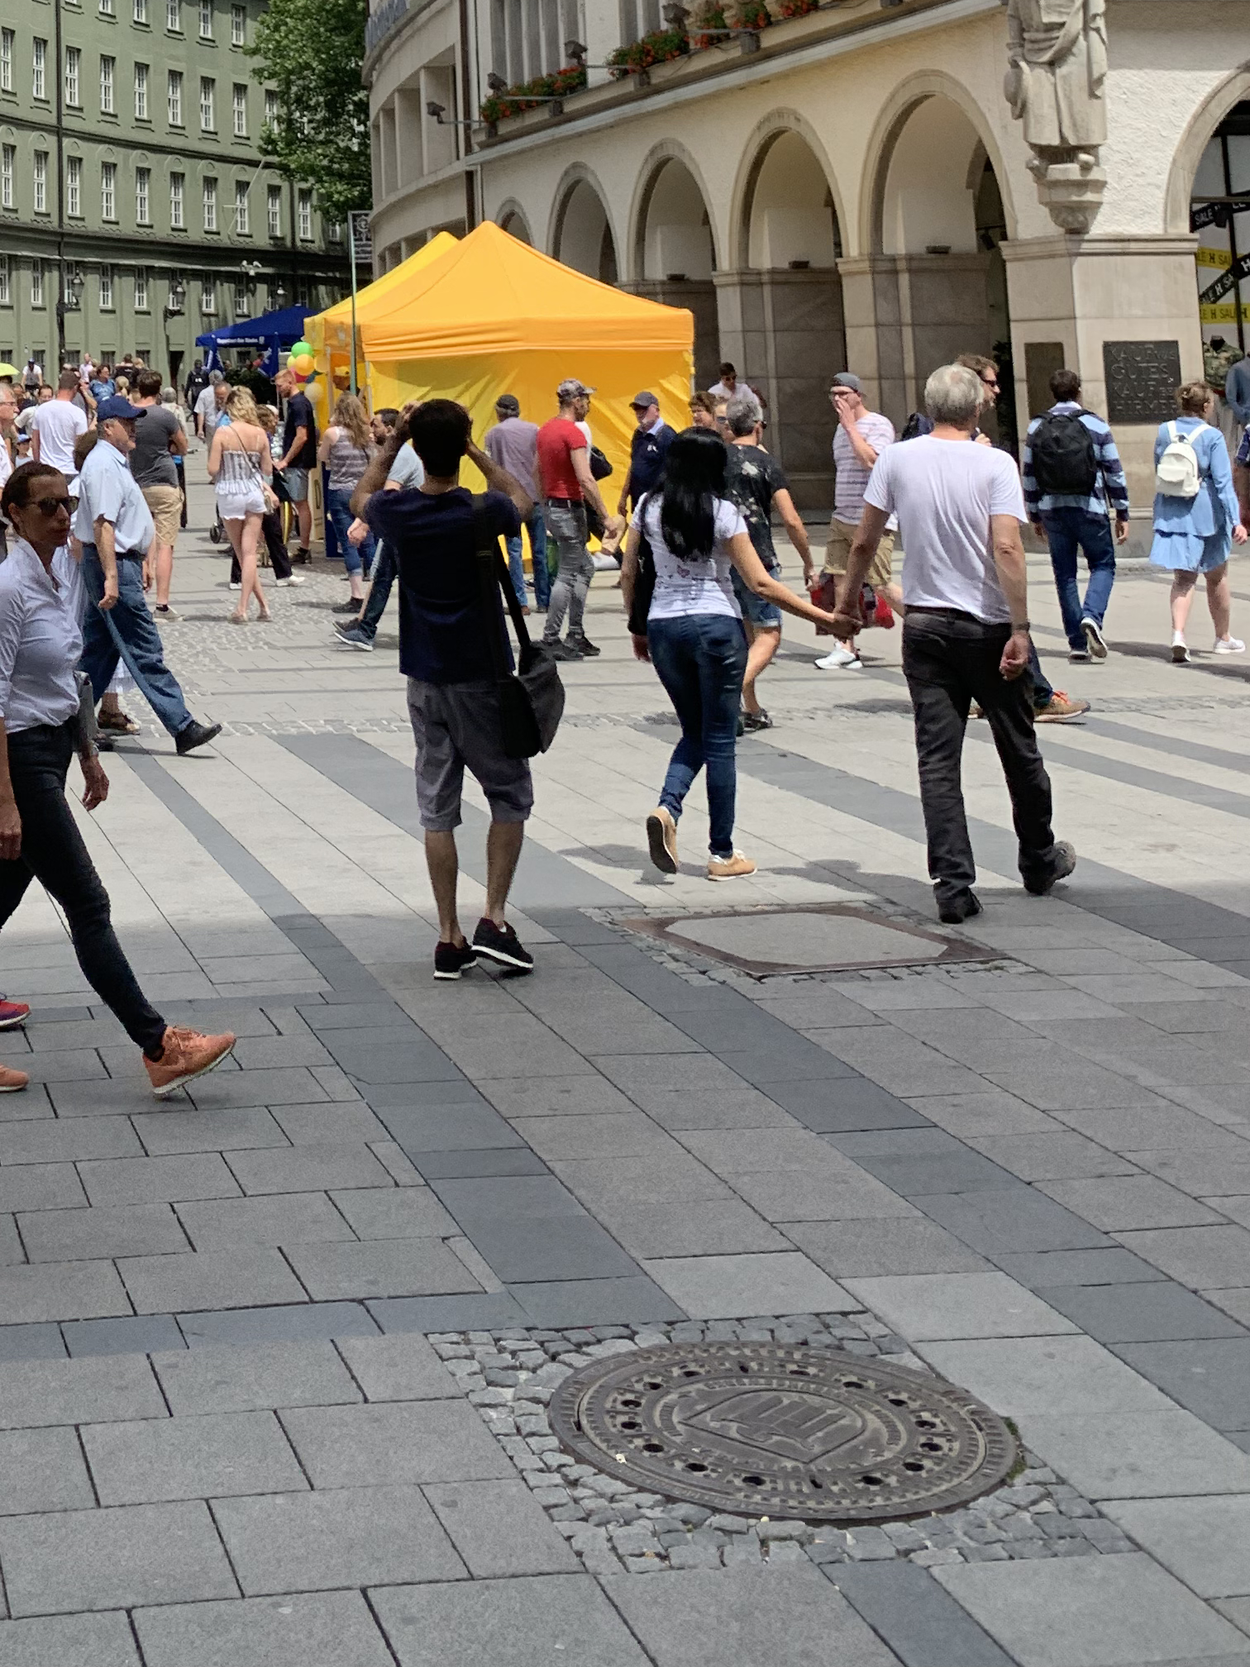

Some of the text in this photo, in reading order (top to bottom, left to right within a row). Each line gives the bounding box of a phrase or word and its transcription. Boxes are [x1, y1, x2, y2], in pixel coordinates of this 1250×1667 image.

[1109, 344, 1154, 361] KAUF
[1111, 363, 1169, 379] GUTES
[1111, 382, 1157, 398] KAUF
